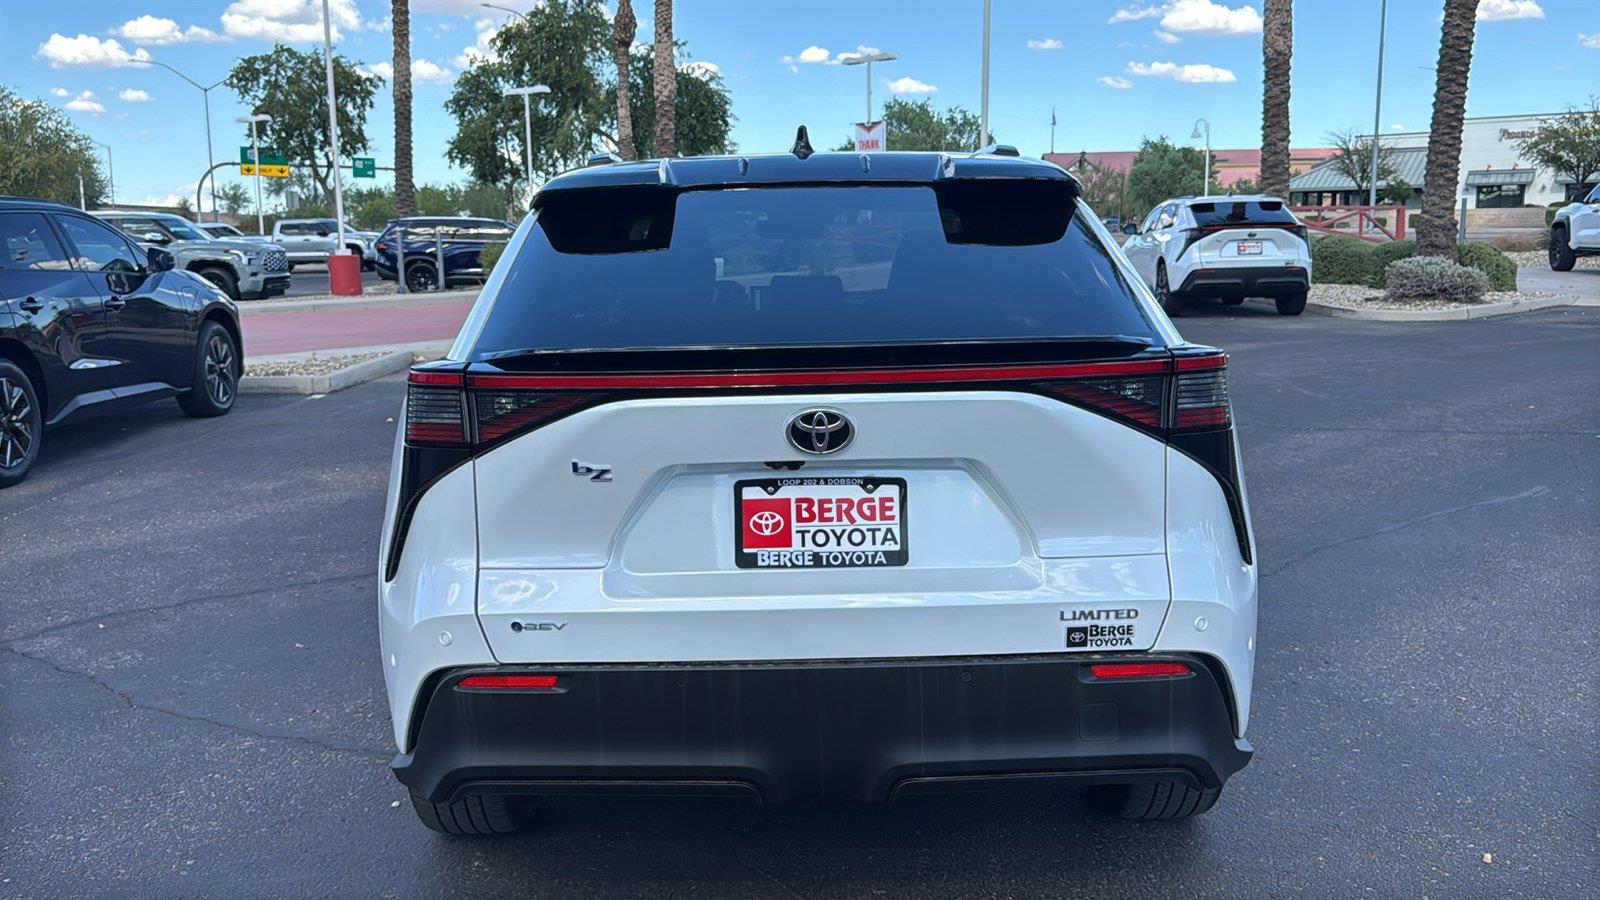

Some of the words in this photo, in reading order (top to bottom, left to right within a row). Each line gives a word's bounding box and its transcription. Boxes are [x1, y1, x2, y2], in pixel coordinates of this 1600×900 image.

[794, 496, 896, 525] BERGE
[795, 527, 899, 548] TOYOTA
[757, 550, 814, 567] BERGE
[819, 551, 887, 565] TOYOTA
[1059, 608, 1139, 621] LIMITED
[1089, 624, 1134, 637] BERGE
[1089, 637, 1133, 647] TOYOTA
